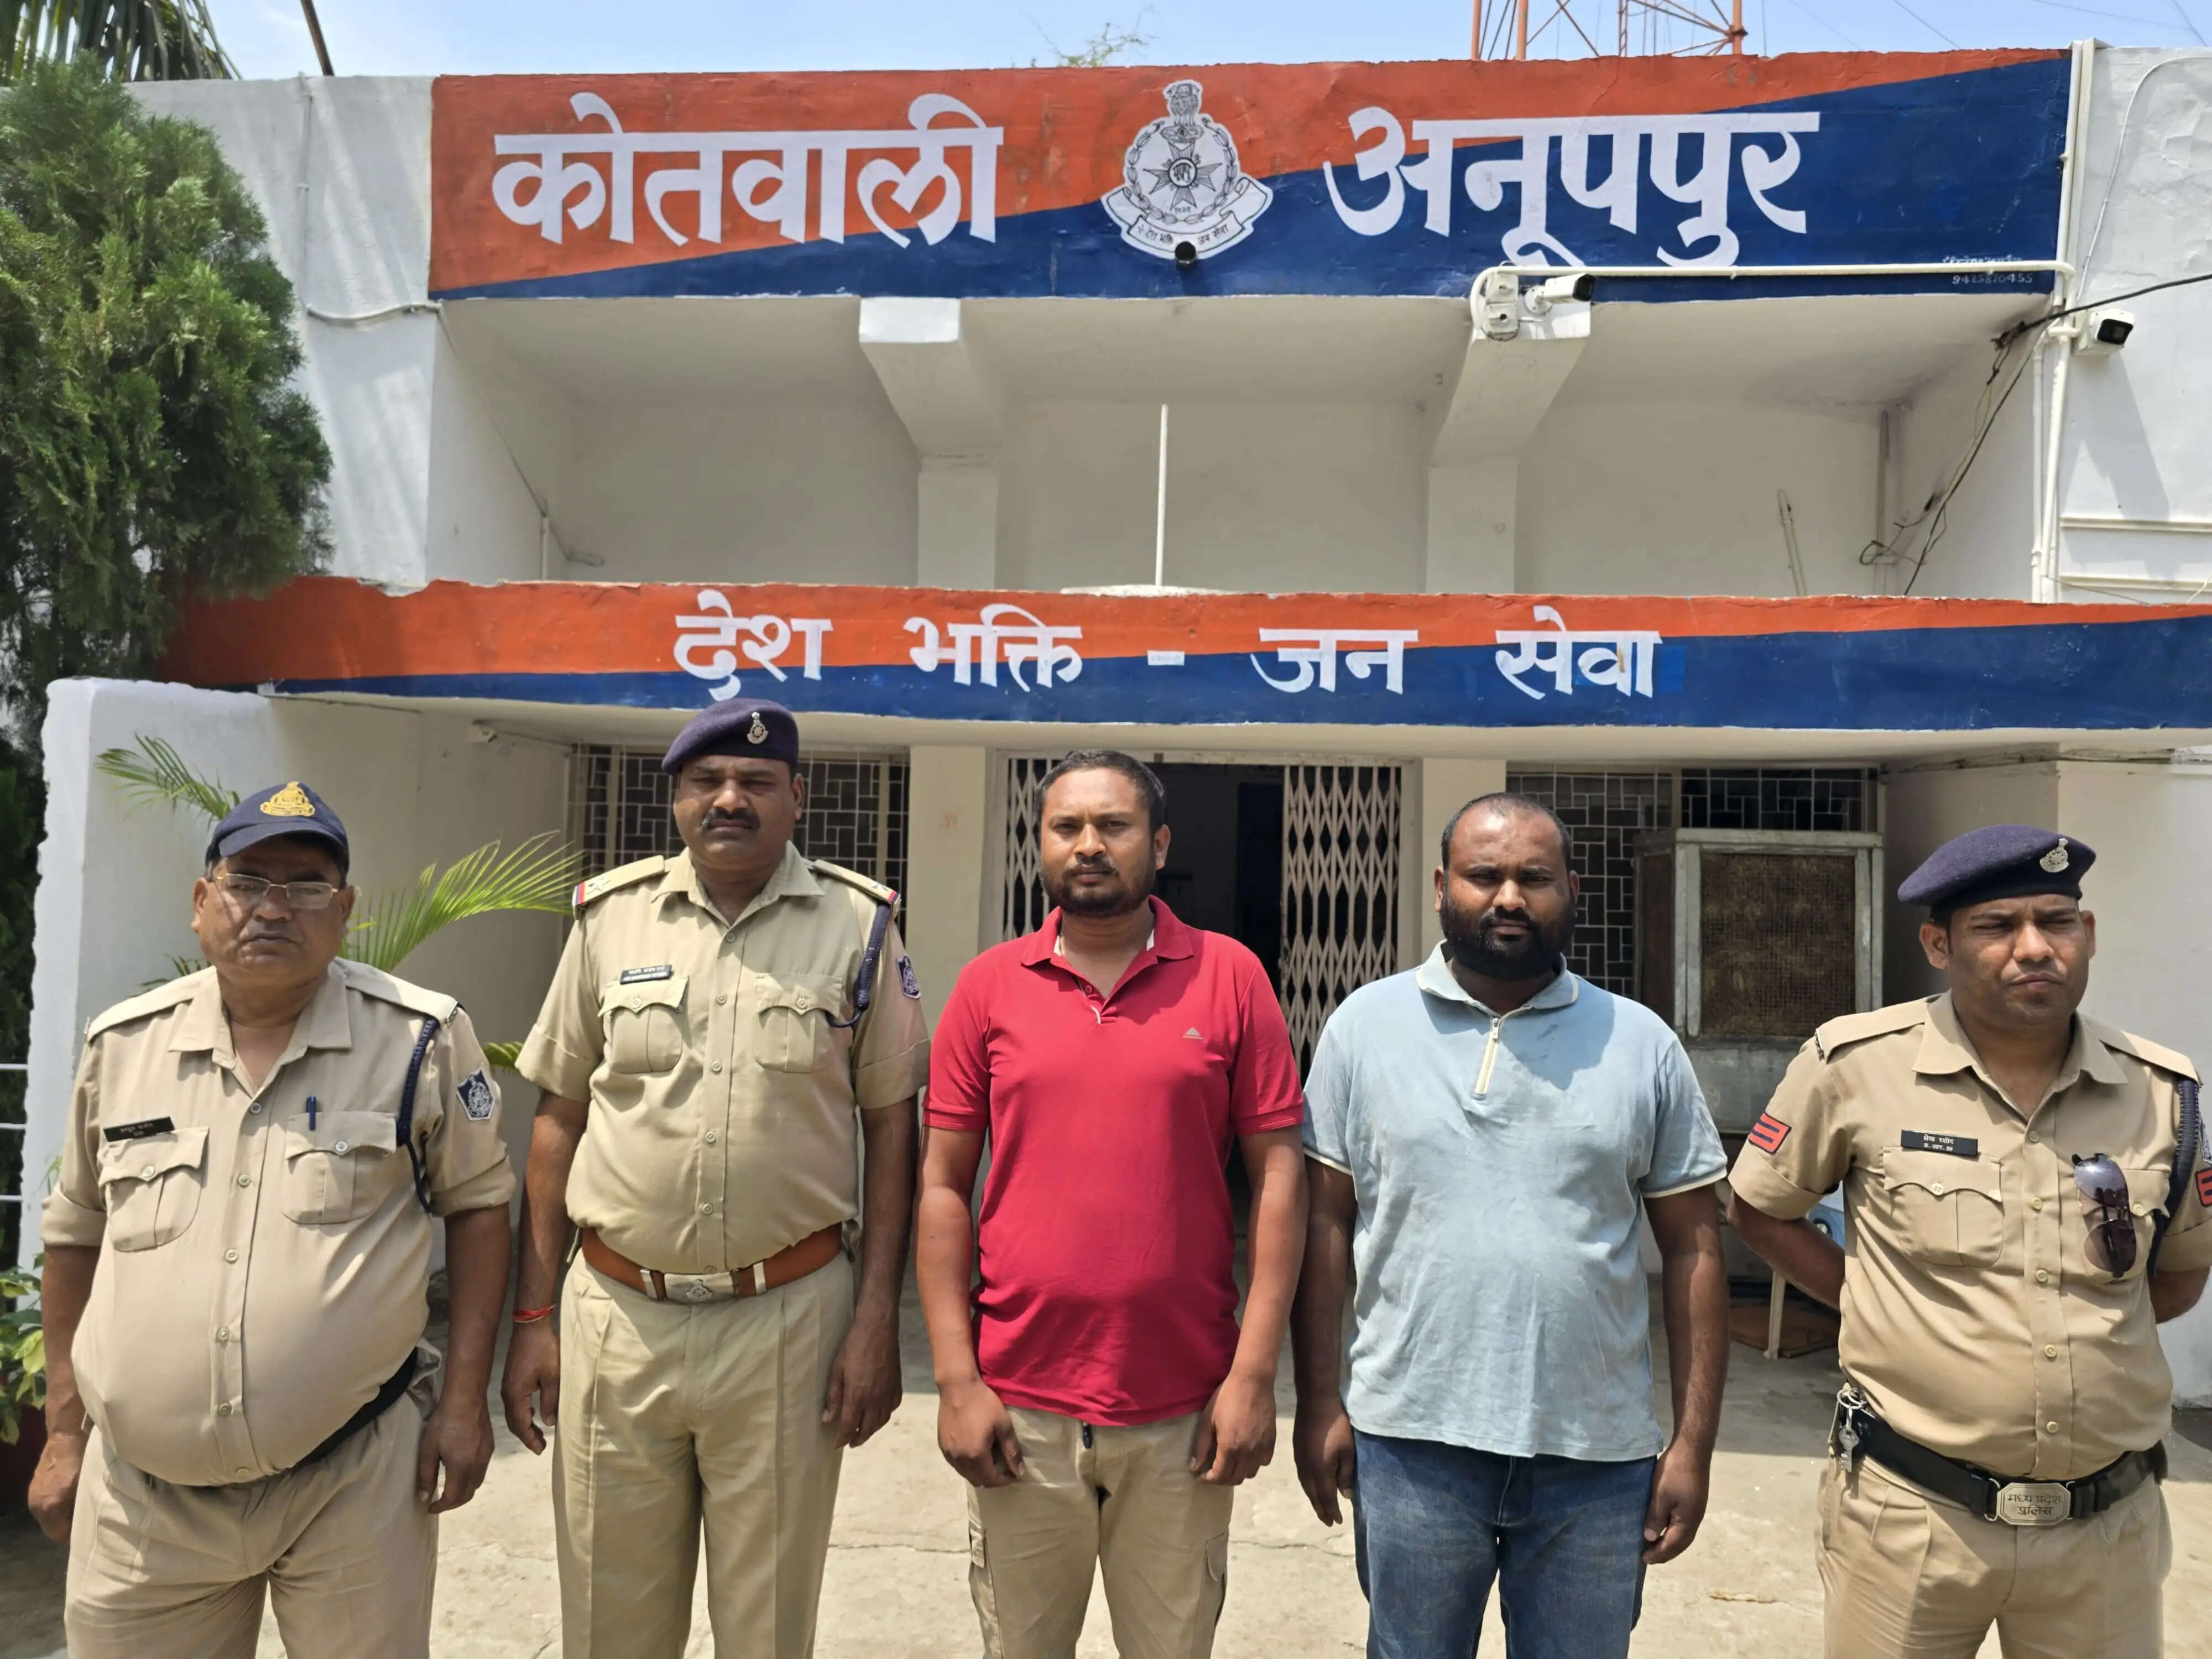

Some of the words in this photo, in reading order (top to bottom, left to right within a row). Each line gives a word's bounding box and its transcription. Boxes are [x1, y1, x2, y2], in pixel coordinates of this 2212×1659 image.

[492, 92, 1004, 248] कोतवाली
[1322, 107, 1820, 267] अनूपपुर
[674, 589, 833, 701] देश
[903, 603, 1082, 692] भक्ति
[1250, 628, 1419, 695] जन
[1494, 606, 1662, 700] सेवा
[2007, 1494, 2032, 1503] मध्य
[2035, 1494, 2061, 1504] प्रदेश
[2017, 1504, 2054, 1515] पुलिस
